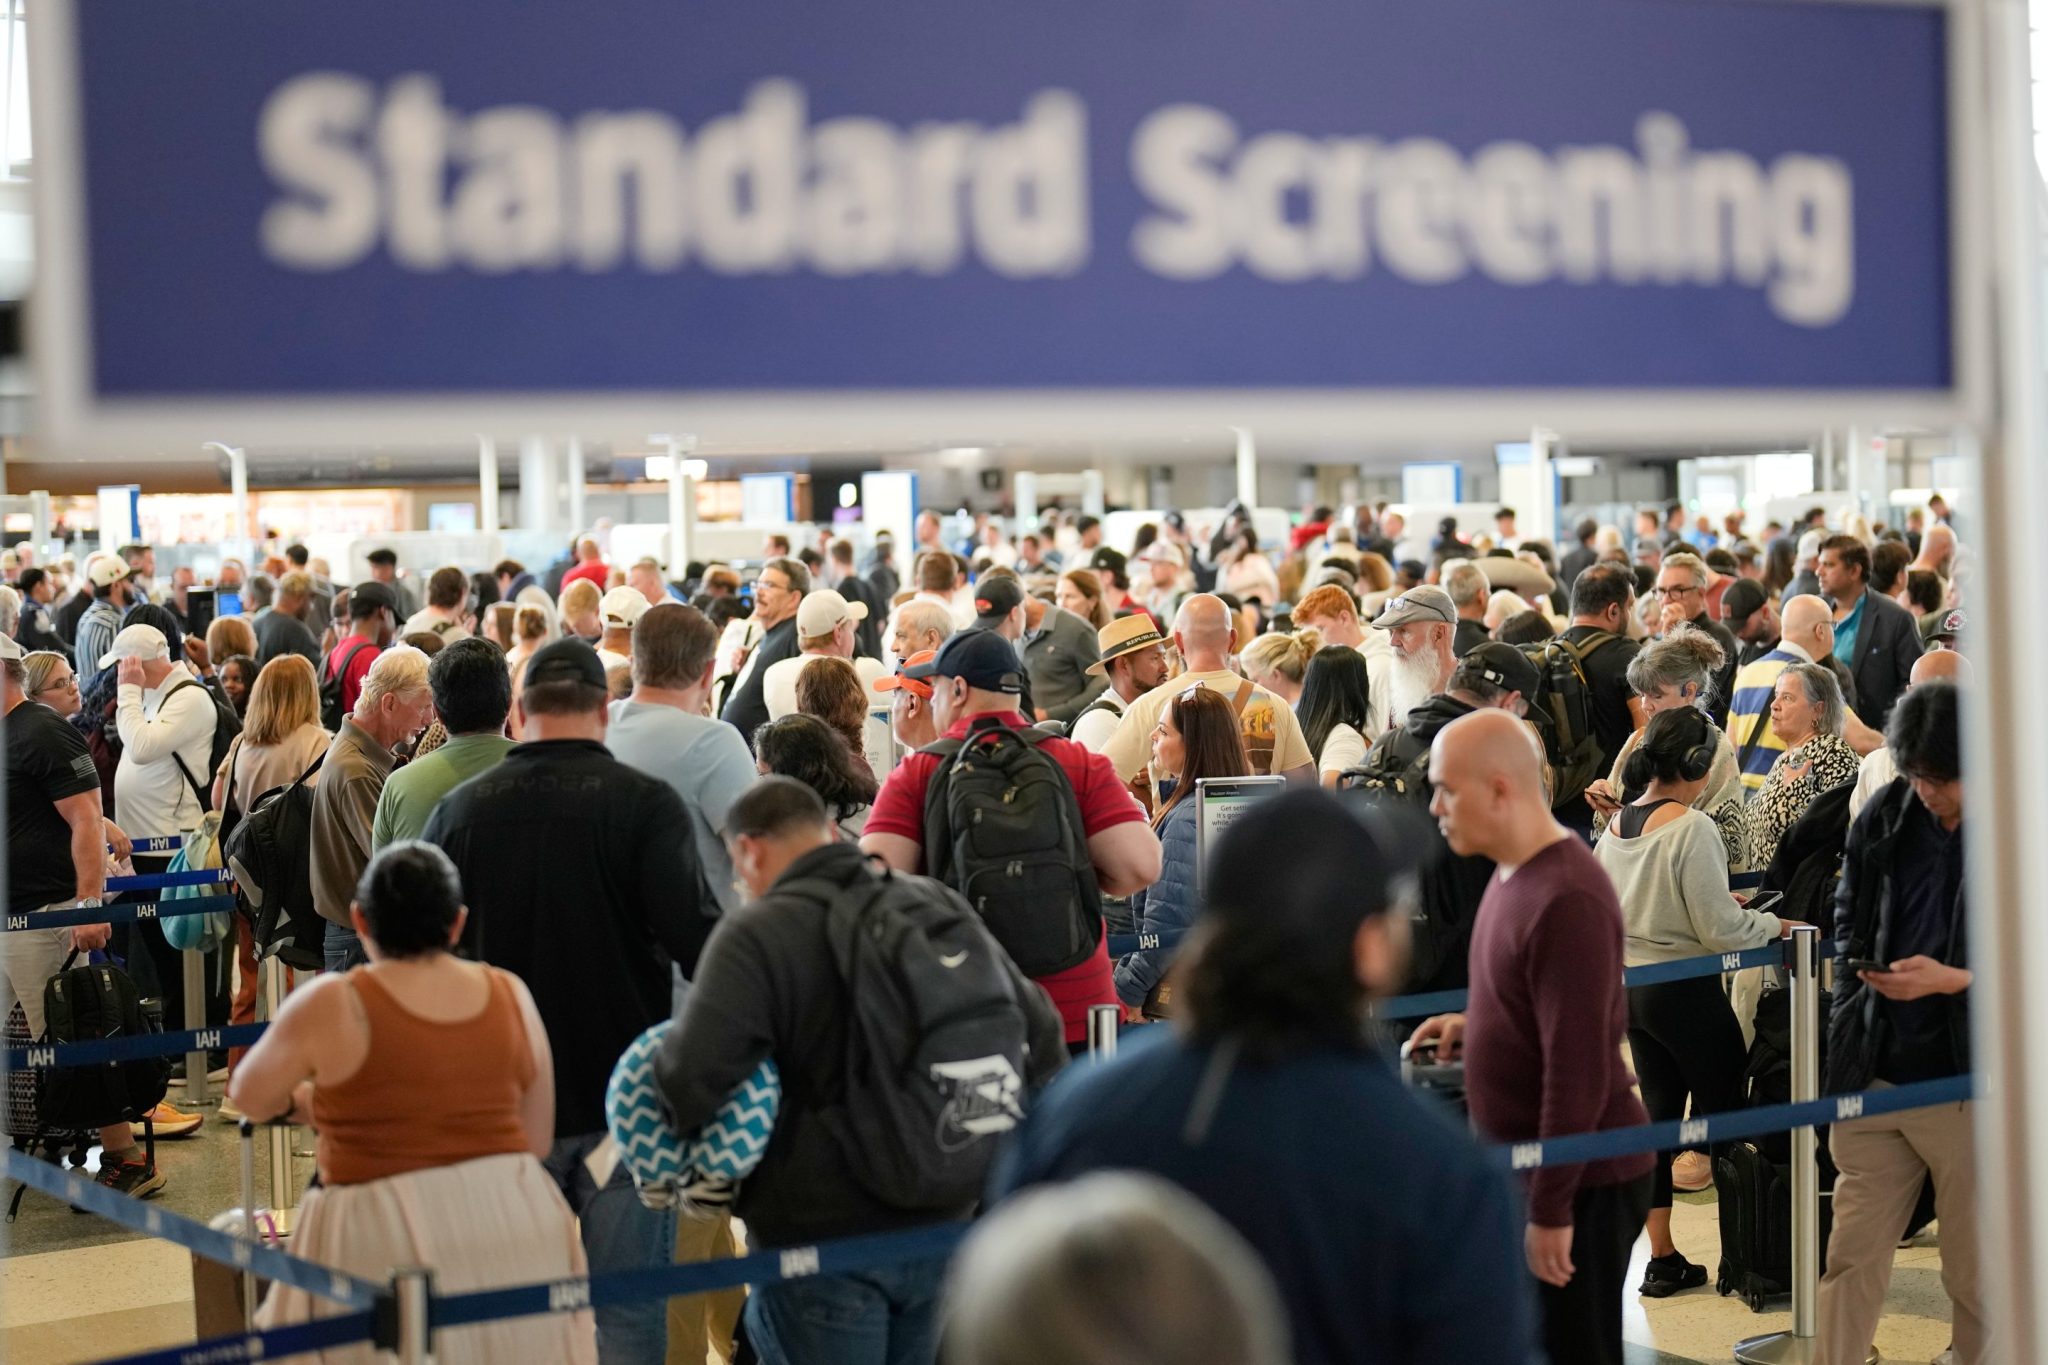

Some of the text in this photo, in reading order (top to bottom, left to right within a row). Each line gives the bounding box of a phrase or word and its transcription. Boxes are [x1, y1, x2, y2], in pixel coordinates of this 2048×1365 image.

[257, 69, 1856, 330] Standard Screening
[475, 775, 604, 798] SPYDER
[1220, 804, 1232, 812] Get
[149, 837, 169, 850] IAH
[7, 904, 156, 931] IAH IAH
[1139, 934, 1160, 950] IAH
[1721, 952, 1741, 970] IAH
[27, 1030, 221, 1067] IAH IAH
[1511, 1094, 1864, 1170] IAH IAH IAH
